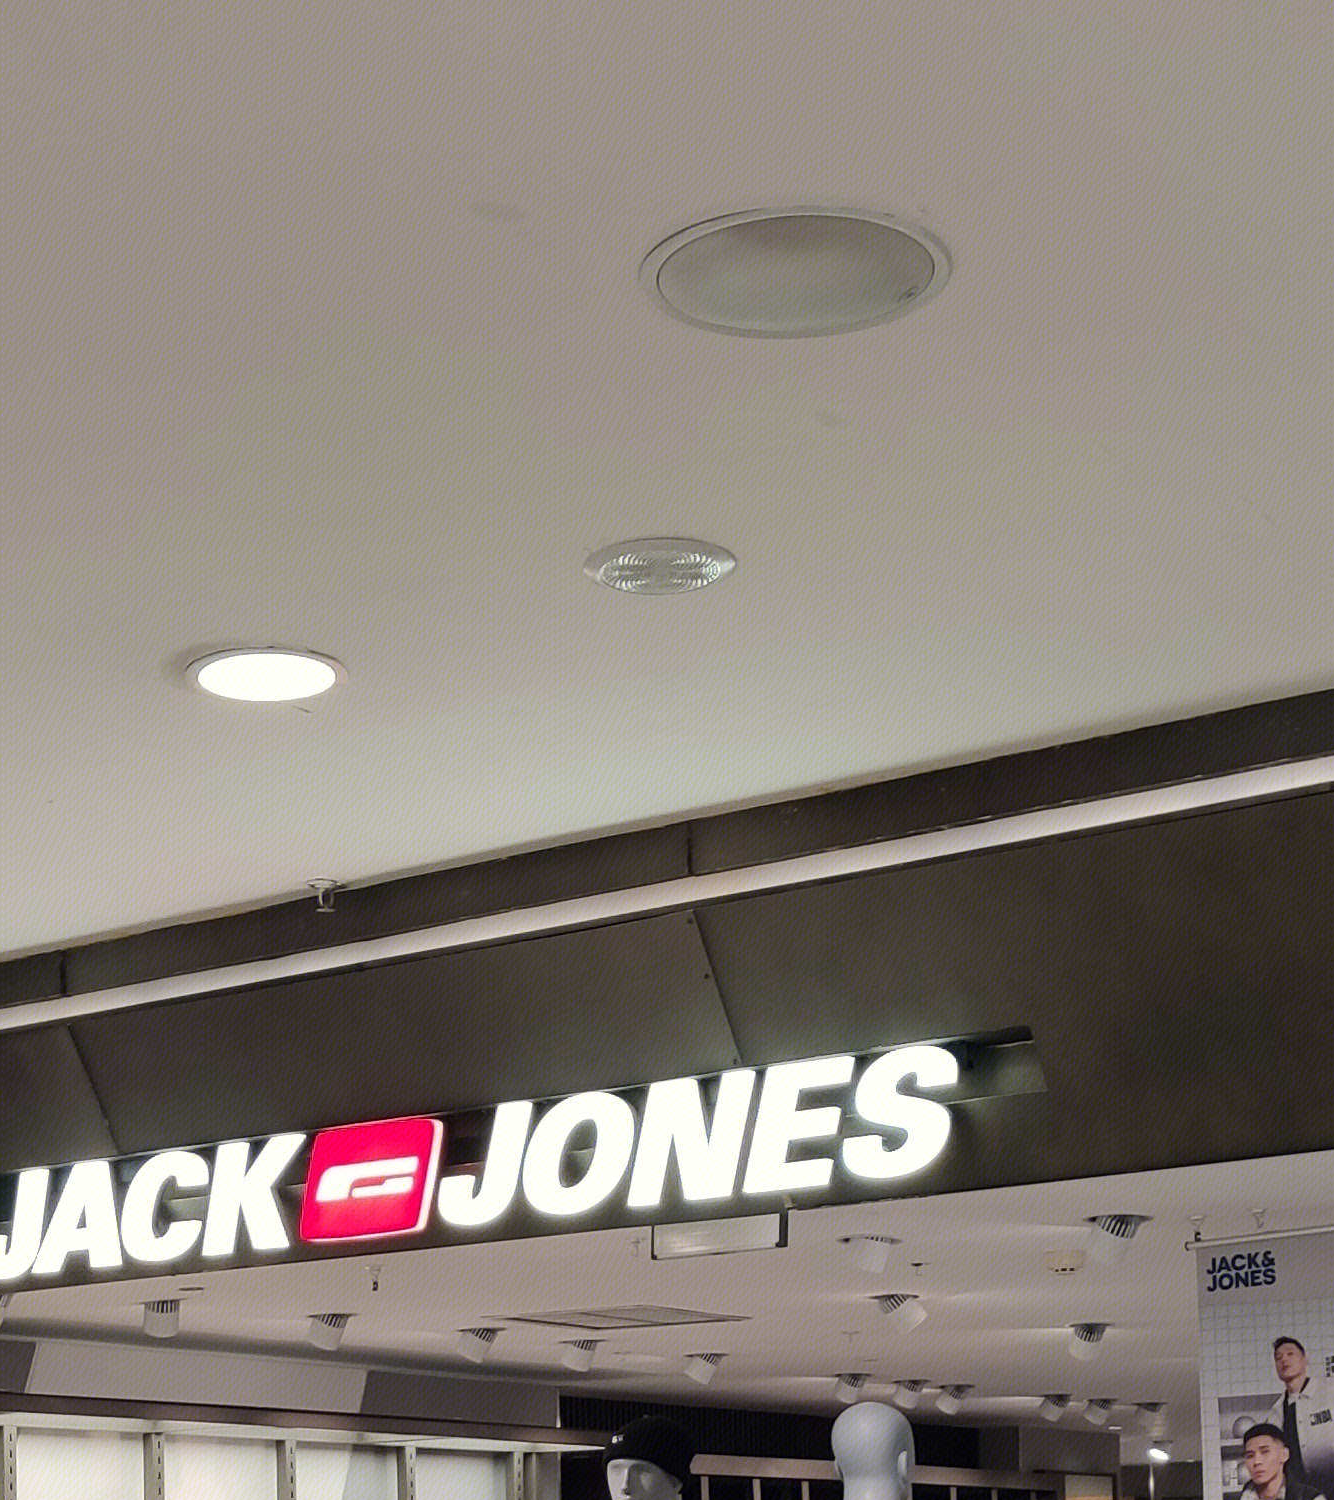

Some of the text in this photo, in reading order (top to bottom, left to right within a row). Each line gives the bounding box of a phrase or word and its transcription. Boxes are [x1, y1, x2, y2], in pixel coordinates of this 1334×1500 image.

[435, 1042, 961, 1227] JONES
[1206, 1250, 1276, 1275] JACK&
[1206, 1269, 1276, 1292] JONES
